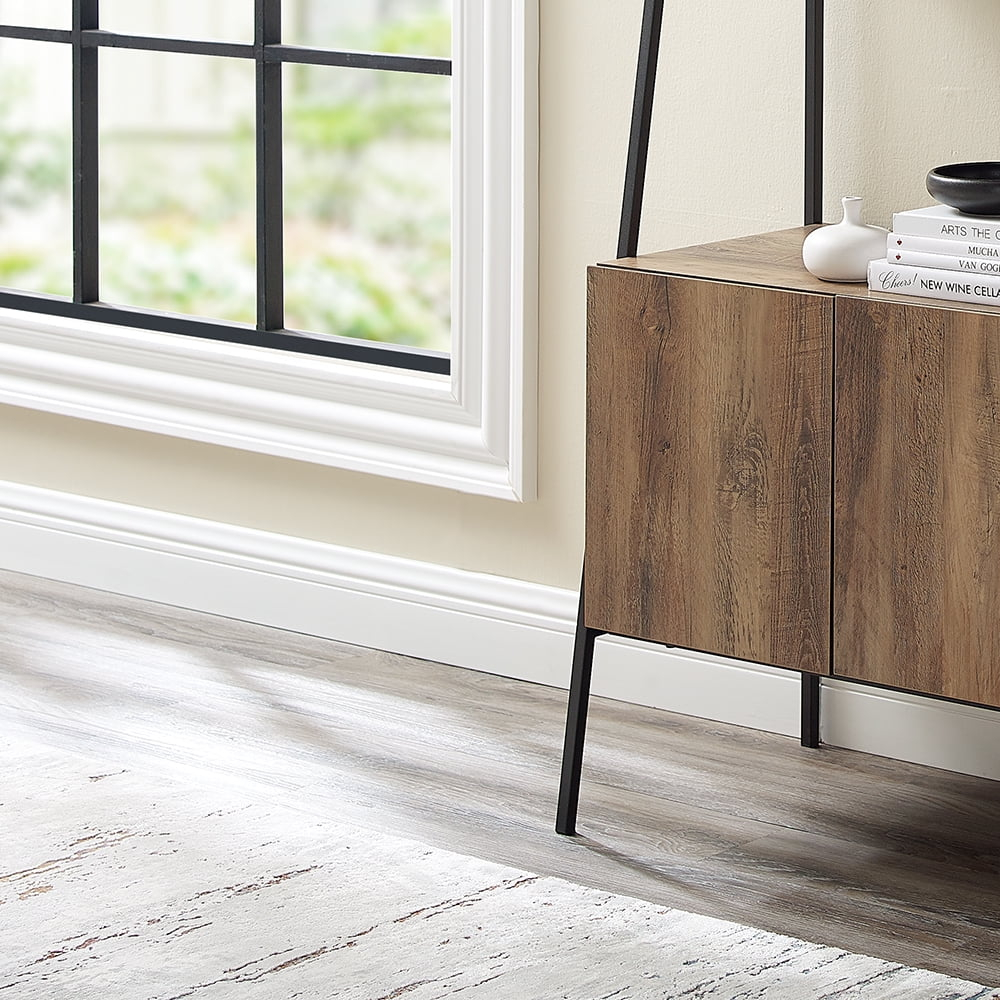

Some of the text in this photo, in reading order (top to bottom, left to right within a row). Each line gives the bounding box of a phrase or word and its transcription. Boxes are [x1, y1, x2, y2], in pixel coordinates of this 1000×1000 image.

[941, 224, 967, 236] ARTS
[971, 228, 991, 239] THE
[968, 246, 999, 257] MUCHA
[959, 260, 977, 270] VAN
[920, 279, 944, 291] NEW
[946, 283, 972, 294] WINE
